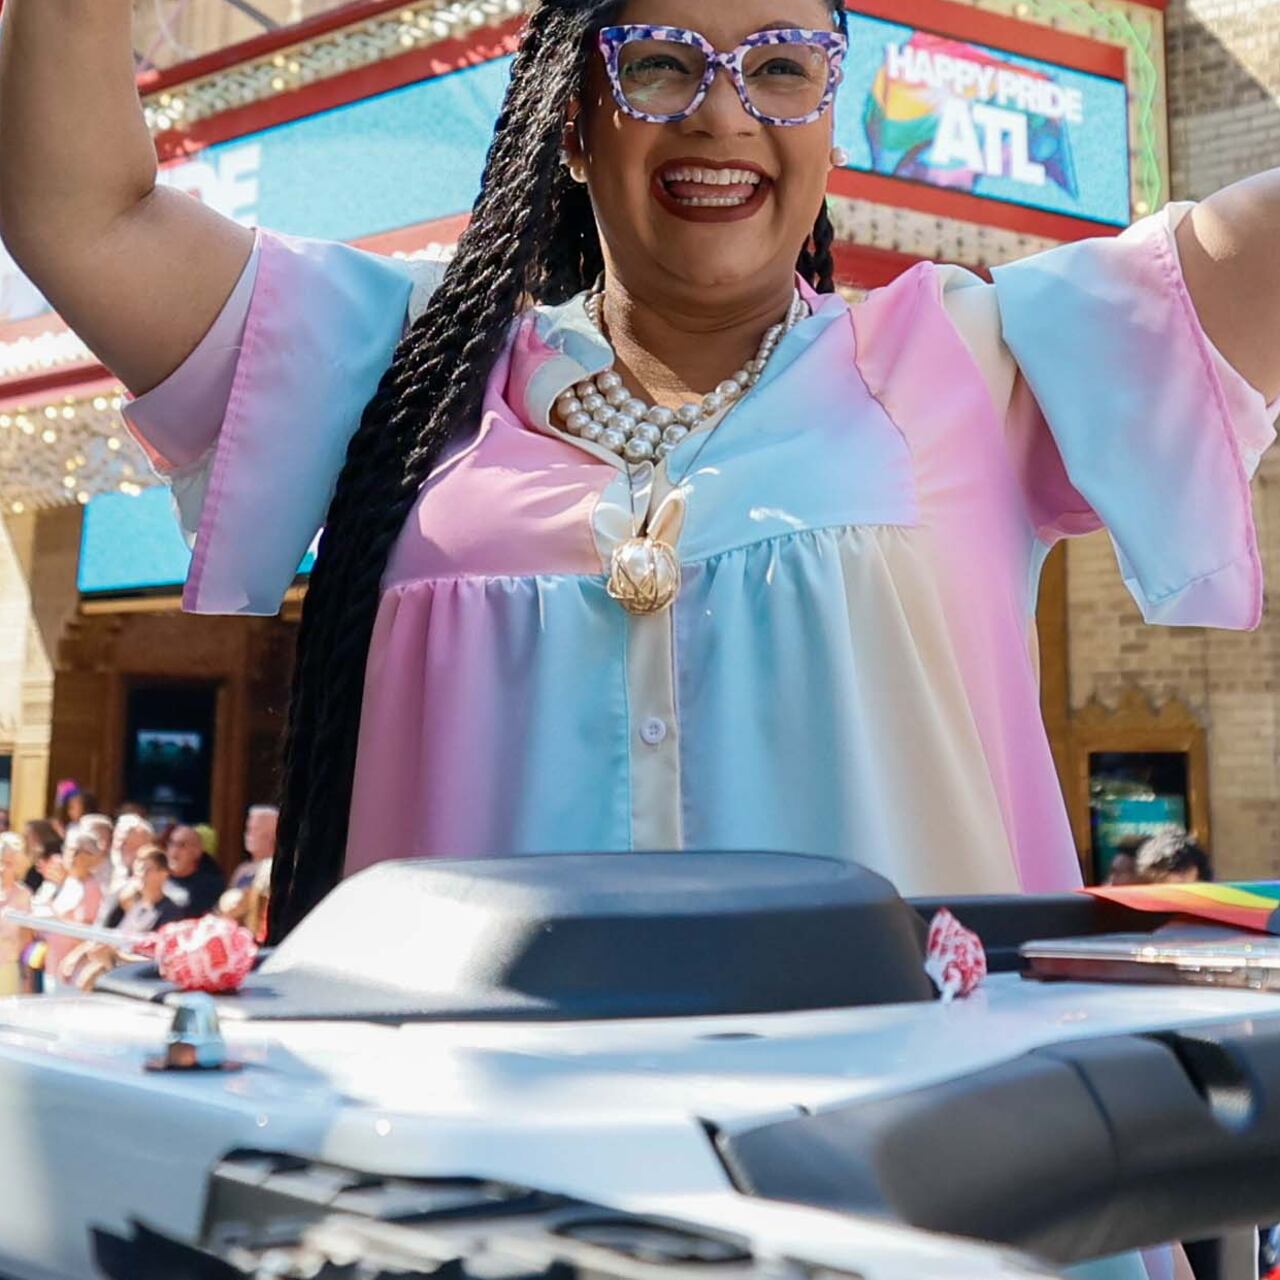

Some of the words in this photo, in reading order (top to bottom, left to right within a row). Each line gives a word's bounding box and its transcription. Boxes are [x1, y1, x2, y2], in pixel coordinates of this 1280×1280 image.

[887, 42, 996, 101] HAPPY
[997, 69, 1084, 126] PRIDE
[928, 96, 1047, 187] ATL
